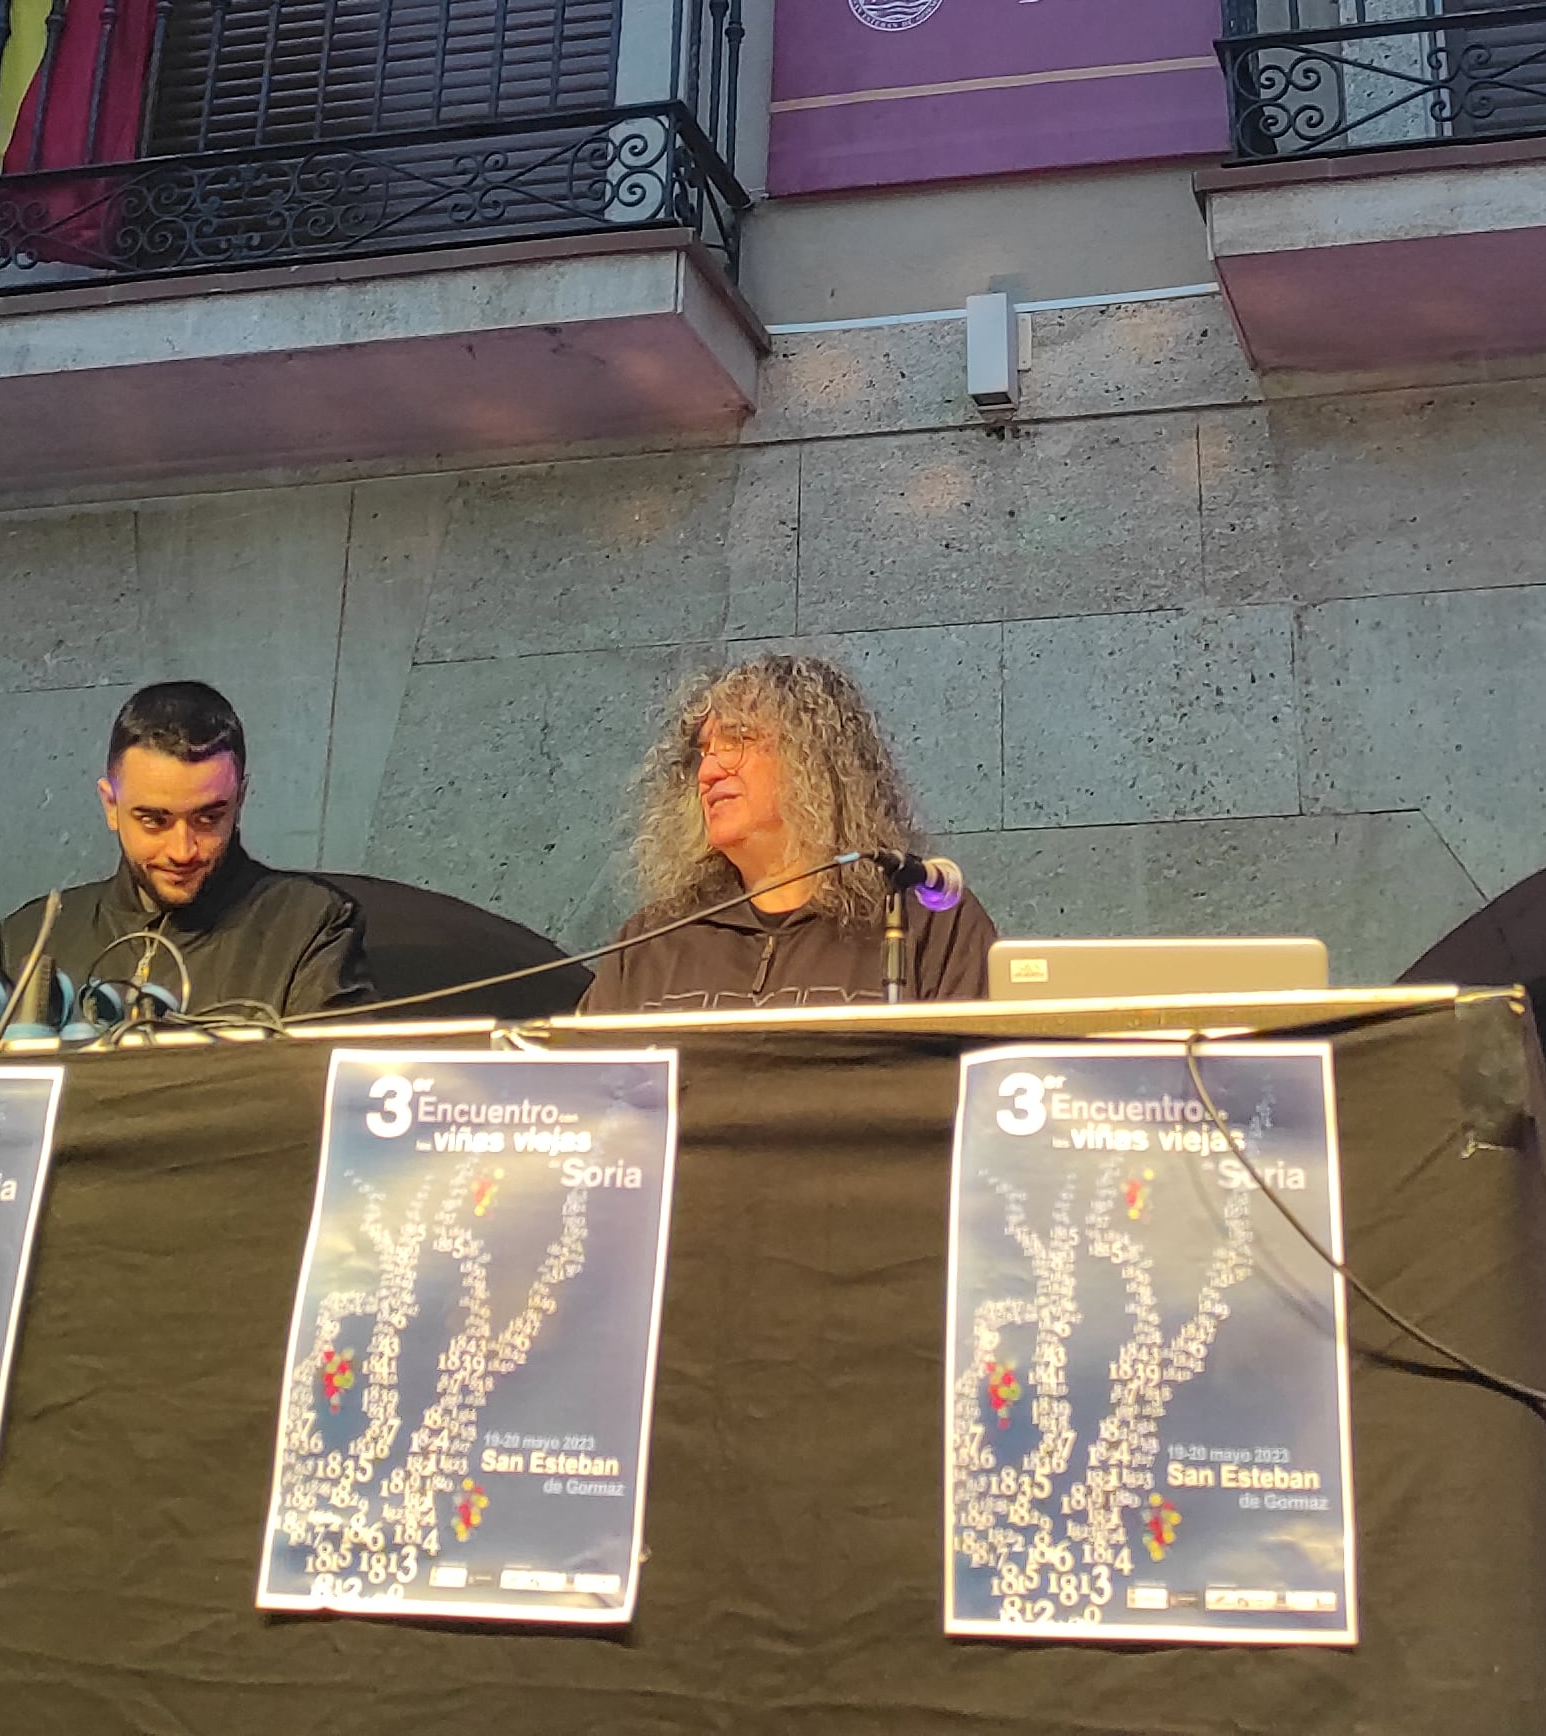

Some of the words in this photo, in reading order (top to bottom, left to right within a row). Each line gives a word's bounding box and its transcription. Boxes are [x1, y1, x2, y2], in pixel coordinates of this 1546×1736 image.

[417, 1095, 558, 1124] Encuentro
[1052, 1094, 1204, 1122] Encuentro
[434, 1126, 505, 1152] viñas
[513, 1126, 592, 1156] viejas
[1070, 1123, 1149, 1151] viñas
[560, 1158, 642, 1189] Soria
[480, 1449, 524, 1473] San
[528, 1451, 619, 1476] Esteban
[543, 1479, 562, 1494] de
[566, 1480, 625, 1497] Gormaz
[1167, 1464, 1215, 1488] San
[1220, 1464, 1321, 1490] Esteban
[358, 1544, 418, 1584] 1813
[1048, 1565, 1113, 1605] 1813
